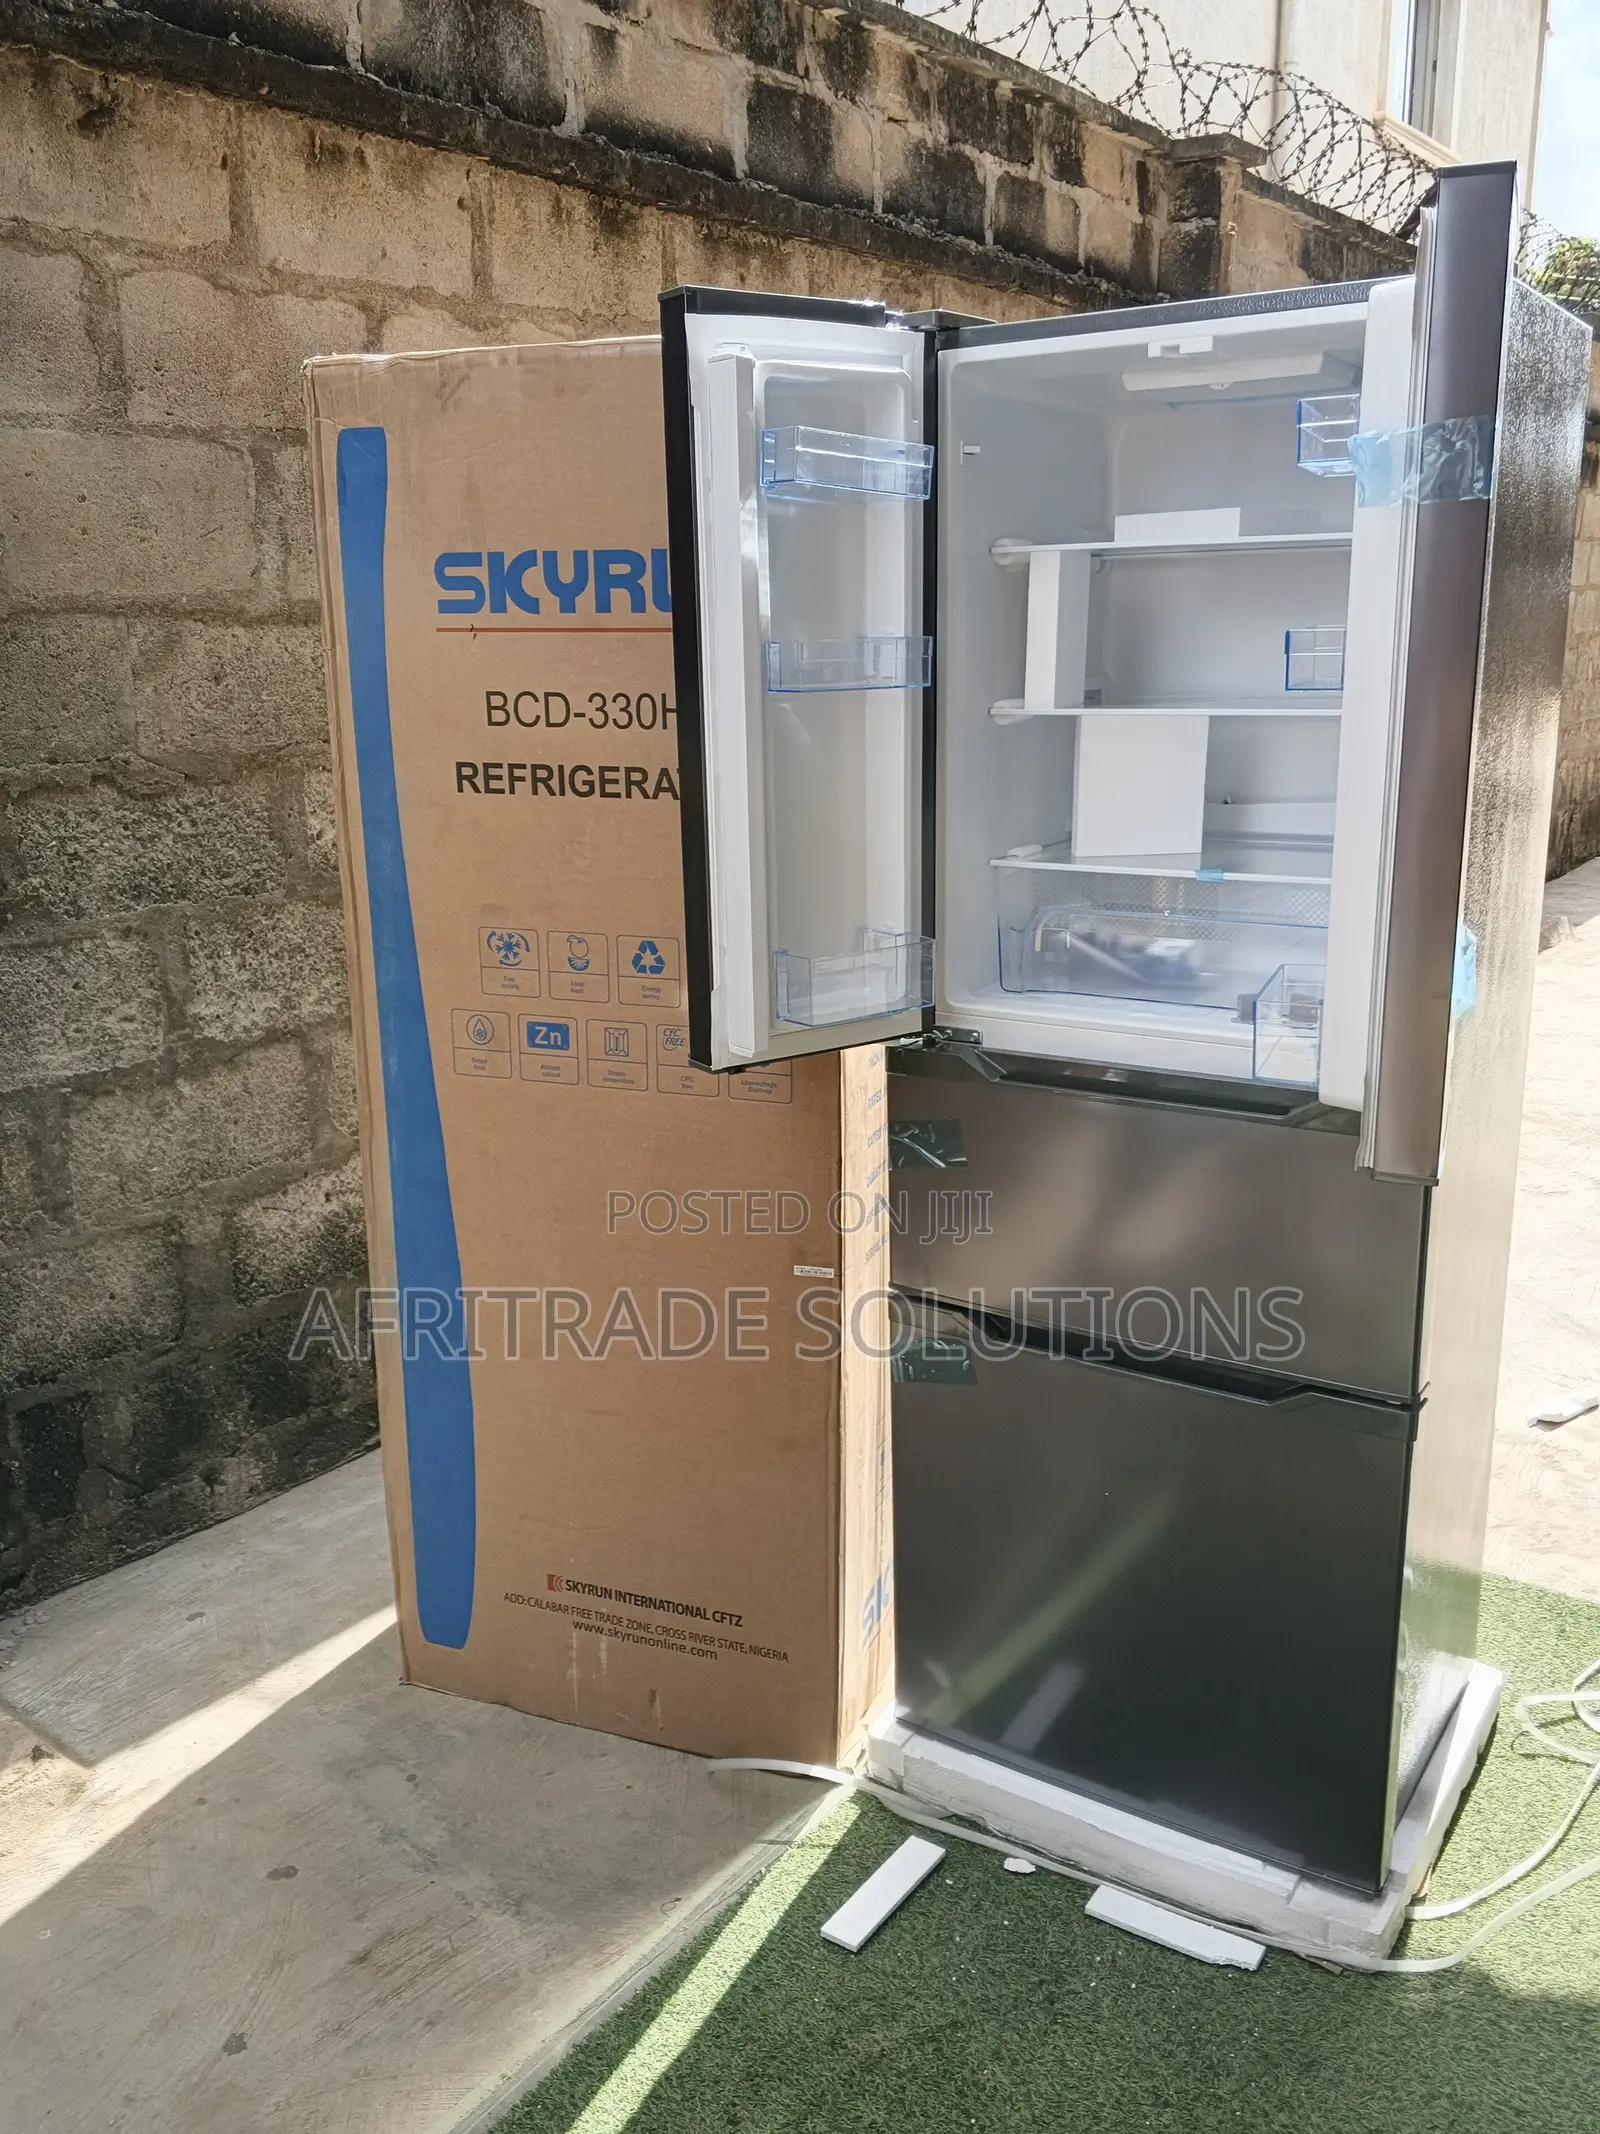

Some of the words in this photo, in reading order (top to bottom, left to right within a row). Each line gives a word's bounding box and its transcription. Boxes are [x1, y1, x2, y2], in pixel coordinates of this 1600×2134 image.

[455, 761, 681, 800] REFRIGERA
[642, 985, 661, 994] Energy
[534, 1026, 562, 1046] Zn
[663, 1027, 681, 1037] CFC
[664, 1036, 685, 1047] FREE
[565, 1579, 613, 1601] SKYRUN
[614, 1589, 711, 1621] INTERNATIONAL
[712, 1610, 743, 1628] CFTZ
[571, 1606, 593, 1621] FREE
[594, 1611, 625, 1628] TRADE
[655, 1625, 687, 1641] CROSS
[688, 1631, 716, 1647] RIVER
[748, 1644, 789, 1663] NIGERIA
[572, 1620, 718, 1661] www.skyrunonline.com
